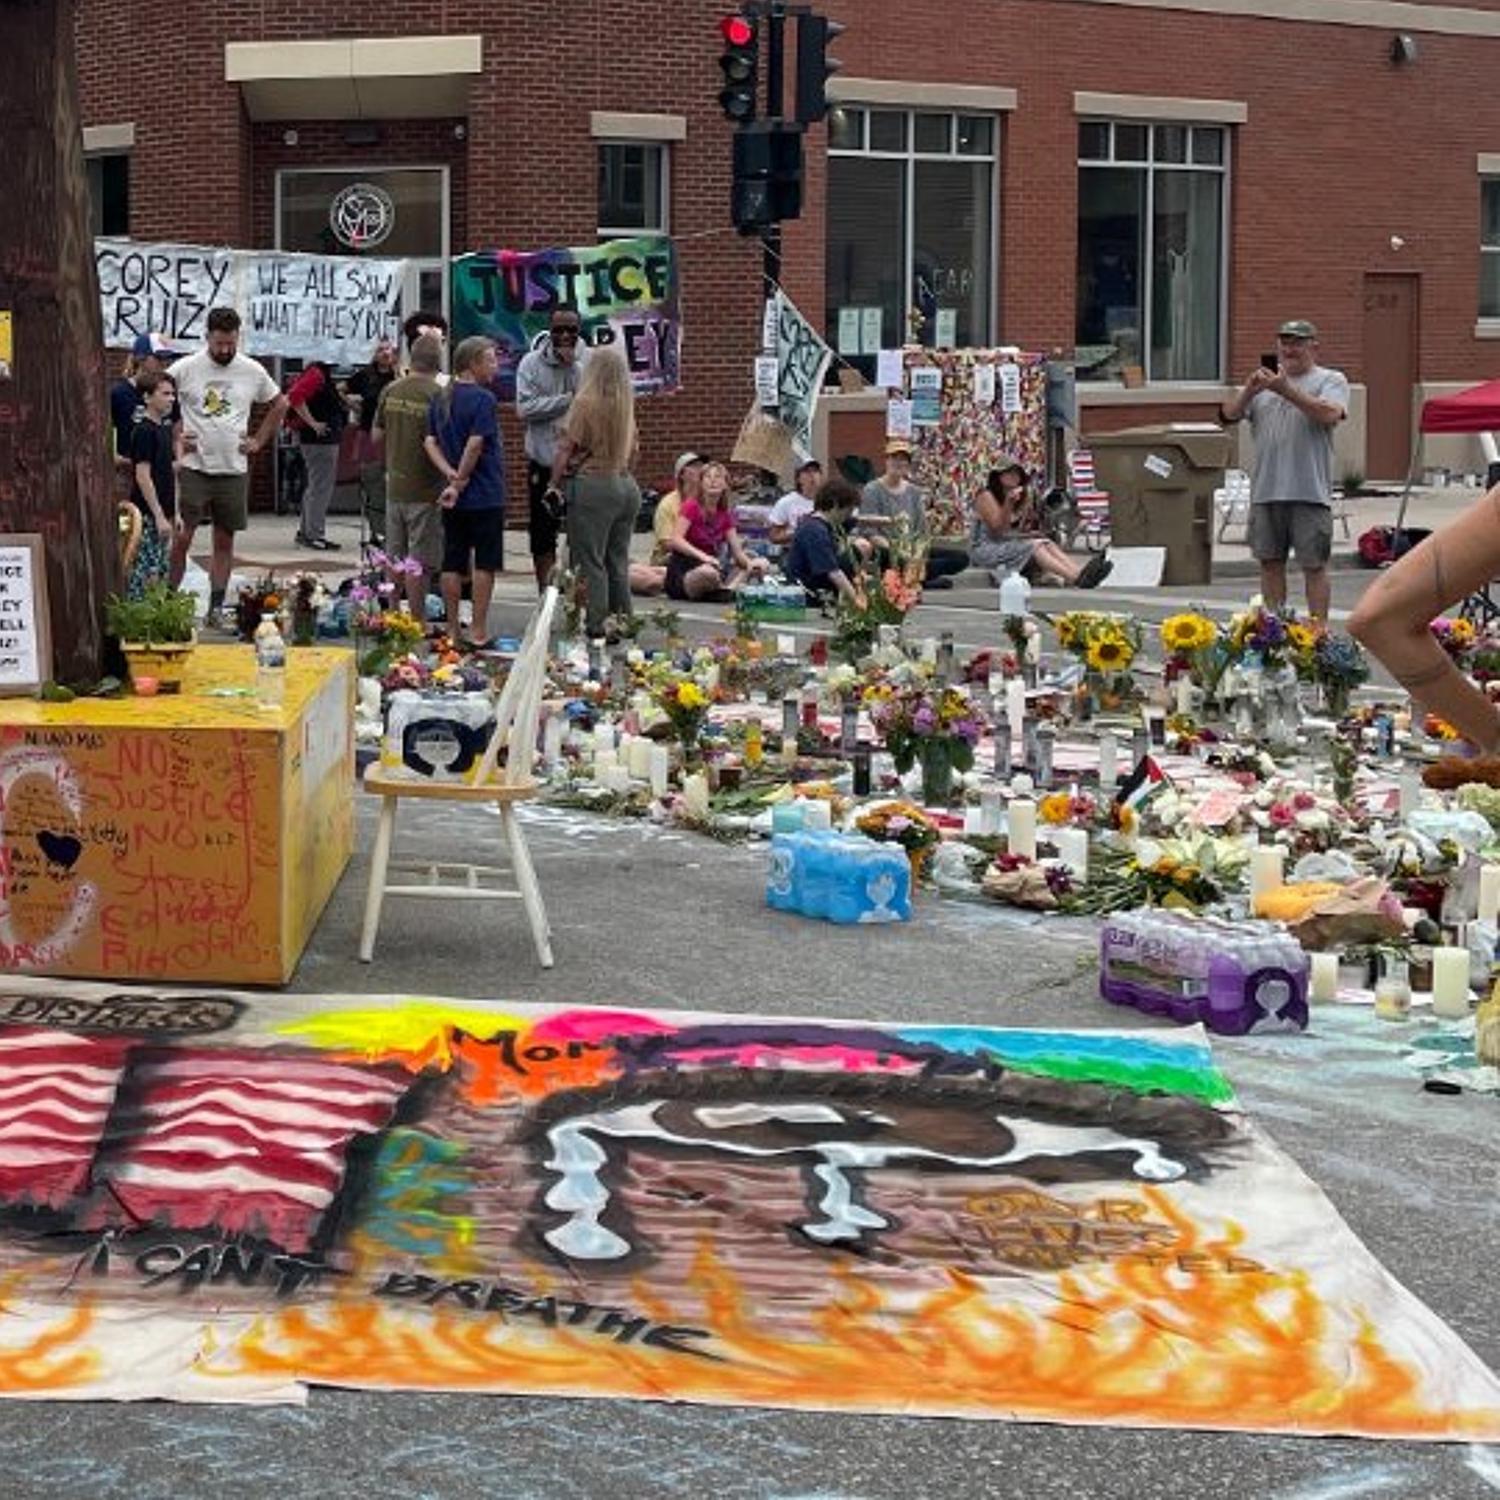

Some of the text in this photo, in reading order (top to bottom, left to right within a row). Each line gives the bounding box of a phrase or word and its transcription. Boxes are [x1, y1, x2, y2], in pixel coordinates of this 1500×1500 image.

[96, 250, 229, 306] COREY
[258, 263, 393, 304] WE ALL SAW
[468, 255, 668, 314] JUSTICE
[252, 300, 299, 336] WHAT
[312, 303, 364, 340] THEY
